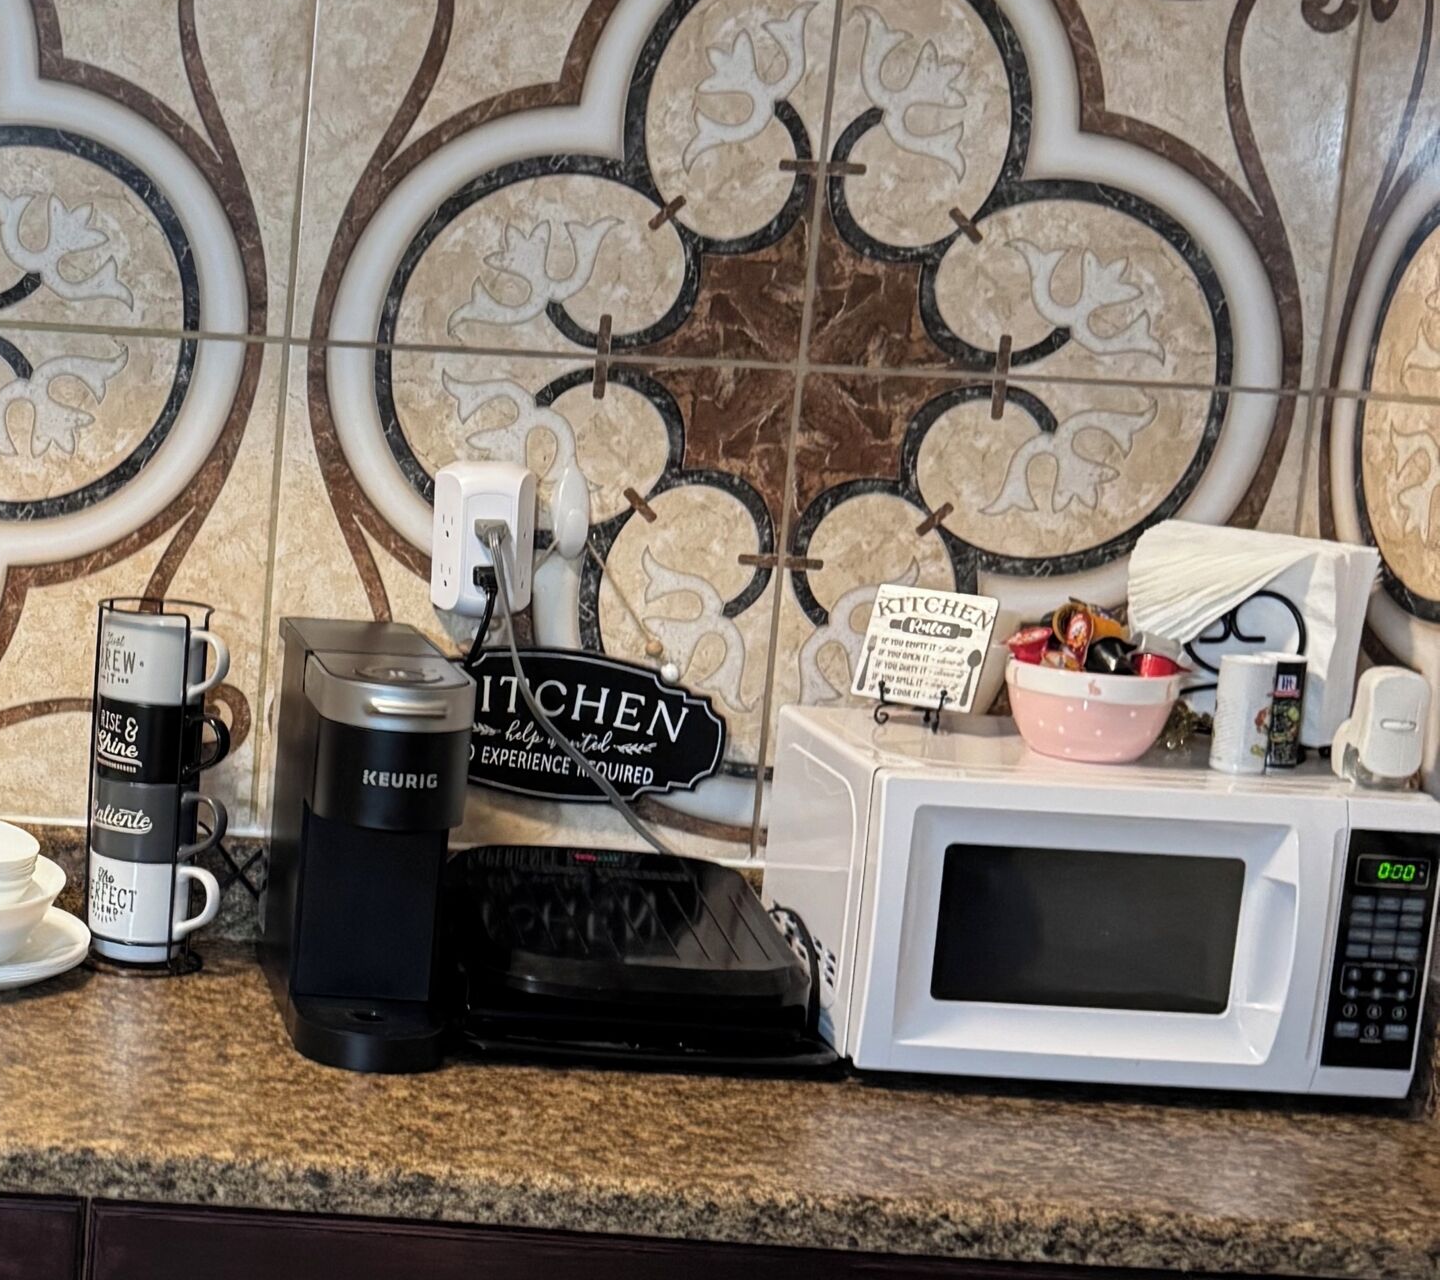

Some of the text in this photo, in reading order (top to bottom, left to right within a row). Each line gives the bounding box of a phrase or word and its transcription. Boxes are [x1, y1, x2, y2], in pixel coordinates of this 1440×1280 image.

[878, 596, 995, 631] KITCHEN
[890, 638, 905, 647] YOU
[100, 709, 139, 743] RISE &
[480, 674, 690, 744] ITCHEN
[97, 729, 139, 758] Shine
[504, 718, 613, 754] help wnted
[481, 746, 572, 776] EXPERIENCE
[362, 768, 438, 789] KEURIG
[90, 879, 138, 913] RFECT
